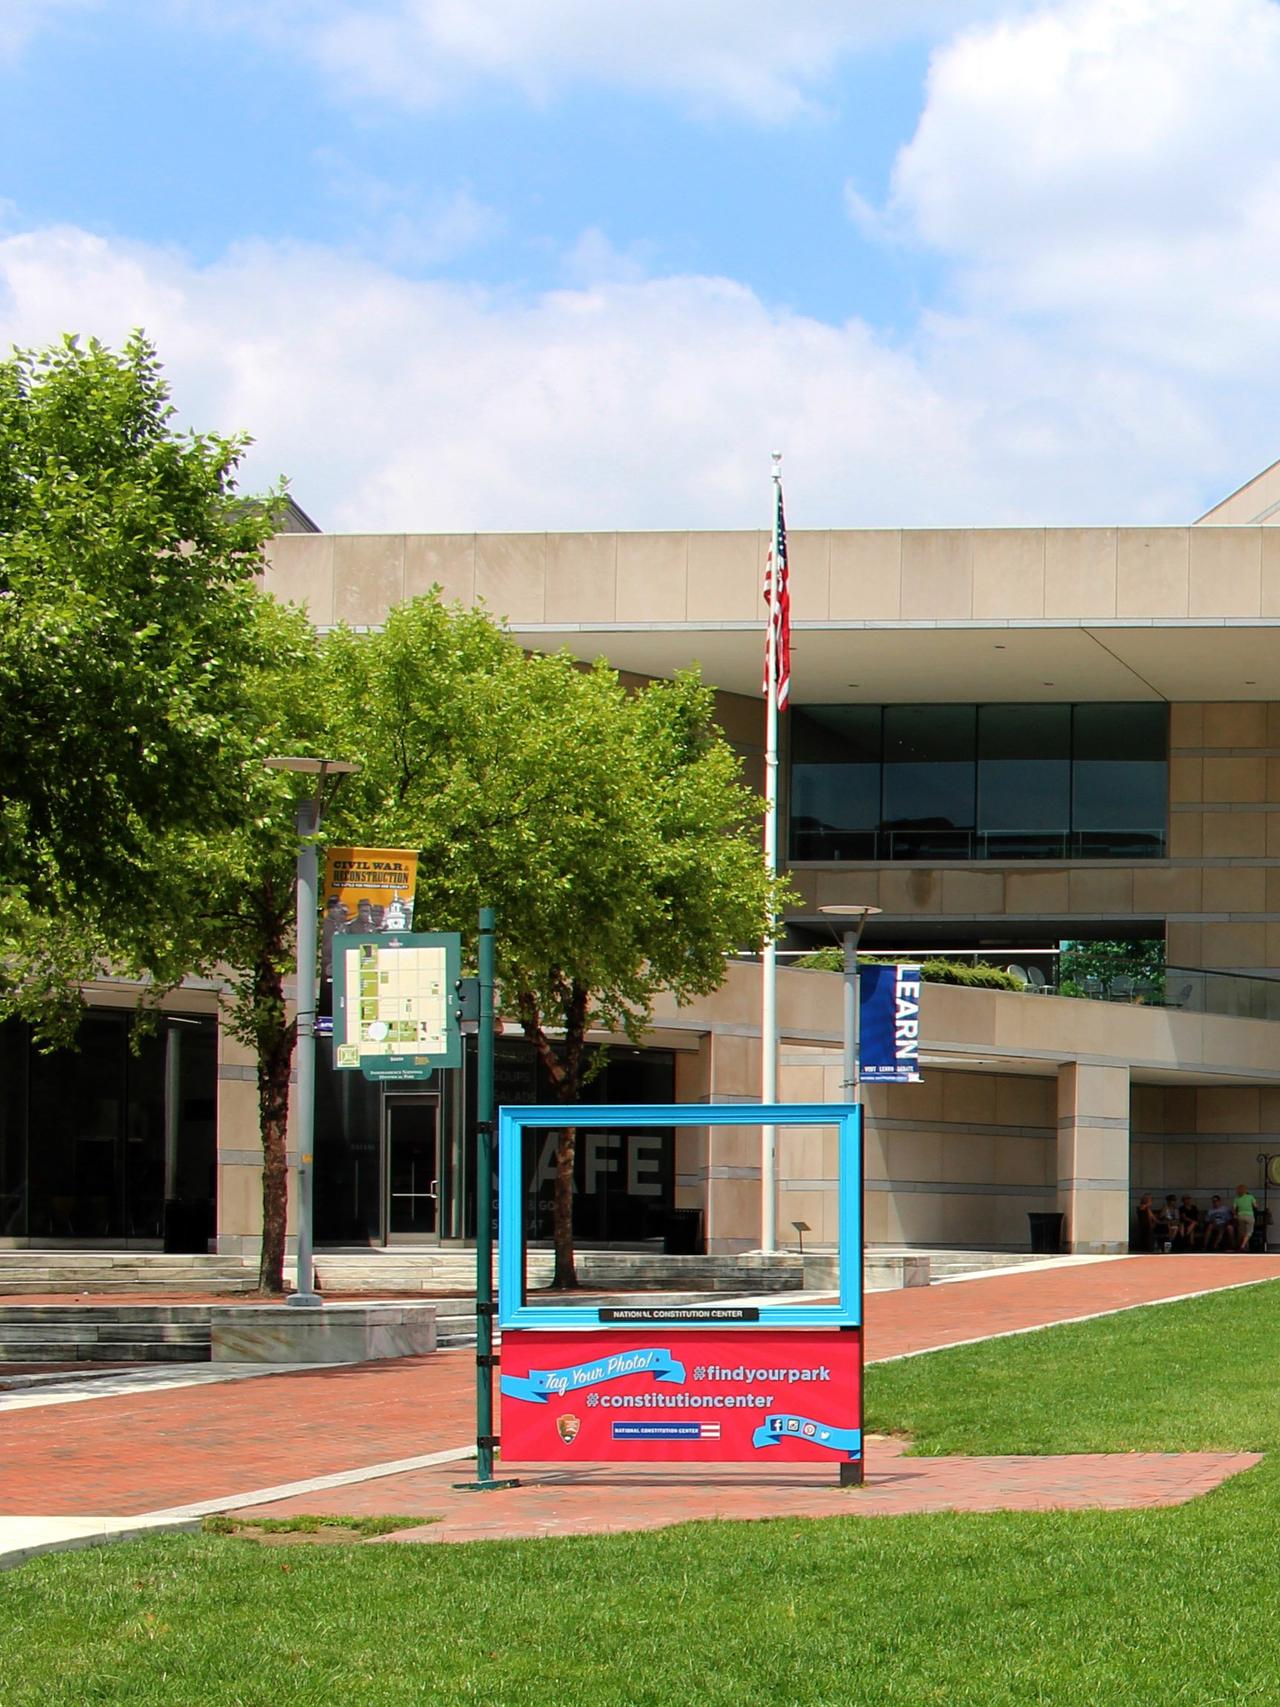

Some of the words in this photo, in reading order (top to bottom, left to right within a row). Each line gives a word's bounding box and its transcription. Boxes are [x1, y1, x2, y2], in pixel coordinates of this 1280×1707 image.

[333, 861, 370, 870] CIVIL
[372, 862, 402, 871] WAR
[333, 870, 409, 884] RECONSTRUCTION
[895, 964, 922, 1059] LEARN
[492, 1130, 662, 1196] AFE
[613, 1310, 652, 1318] NATIONAL
[653, 1310, 710, 1318] CONSTITUTION
[711, 1310, 743, 1318] CENTER
[544, 1372, 570, 1397] Tag
[572, 1368, 605, 1385] Your
[606, 1351, 654, 1376] Photo!
[693, 1365, 831, 1384] #findyourpark
[585, 1392, 775, 1408] #constitutioncenter
